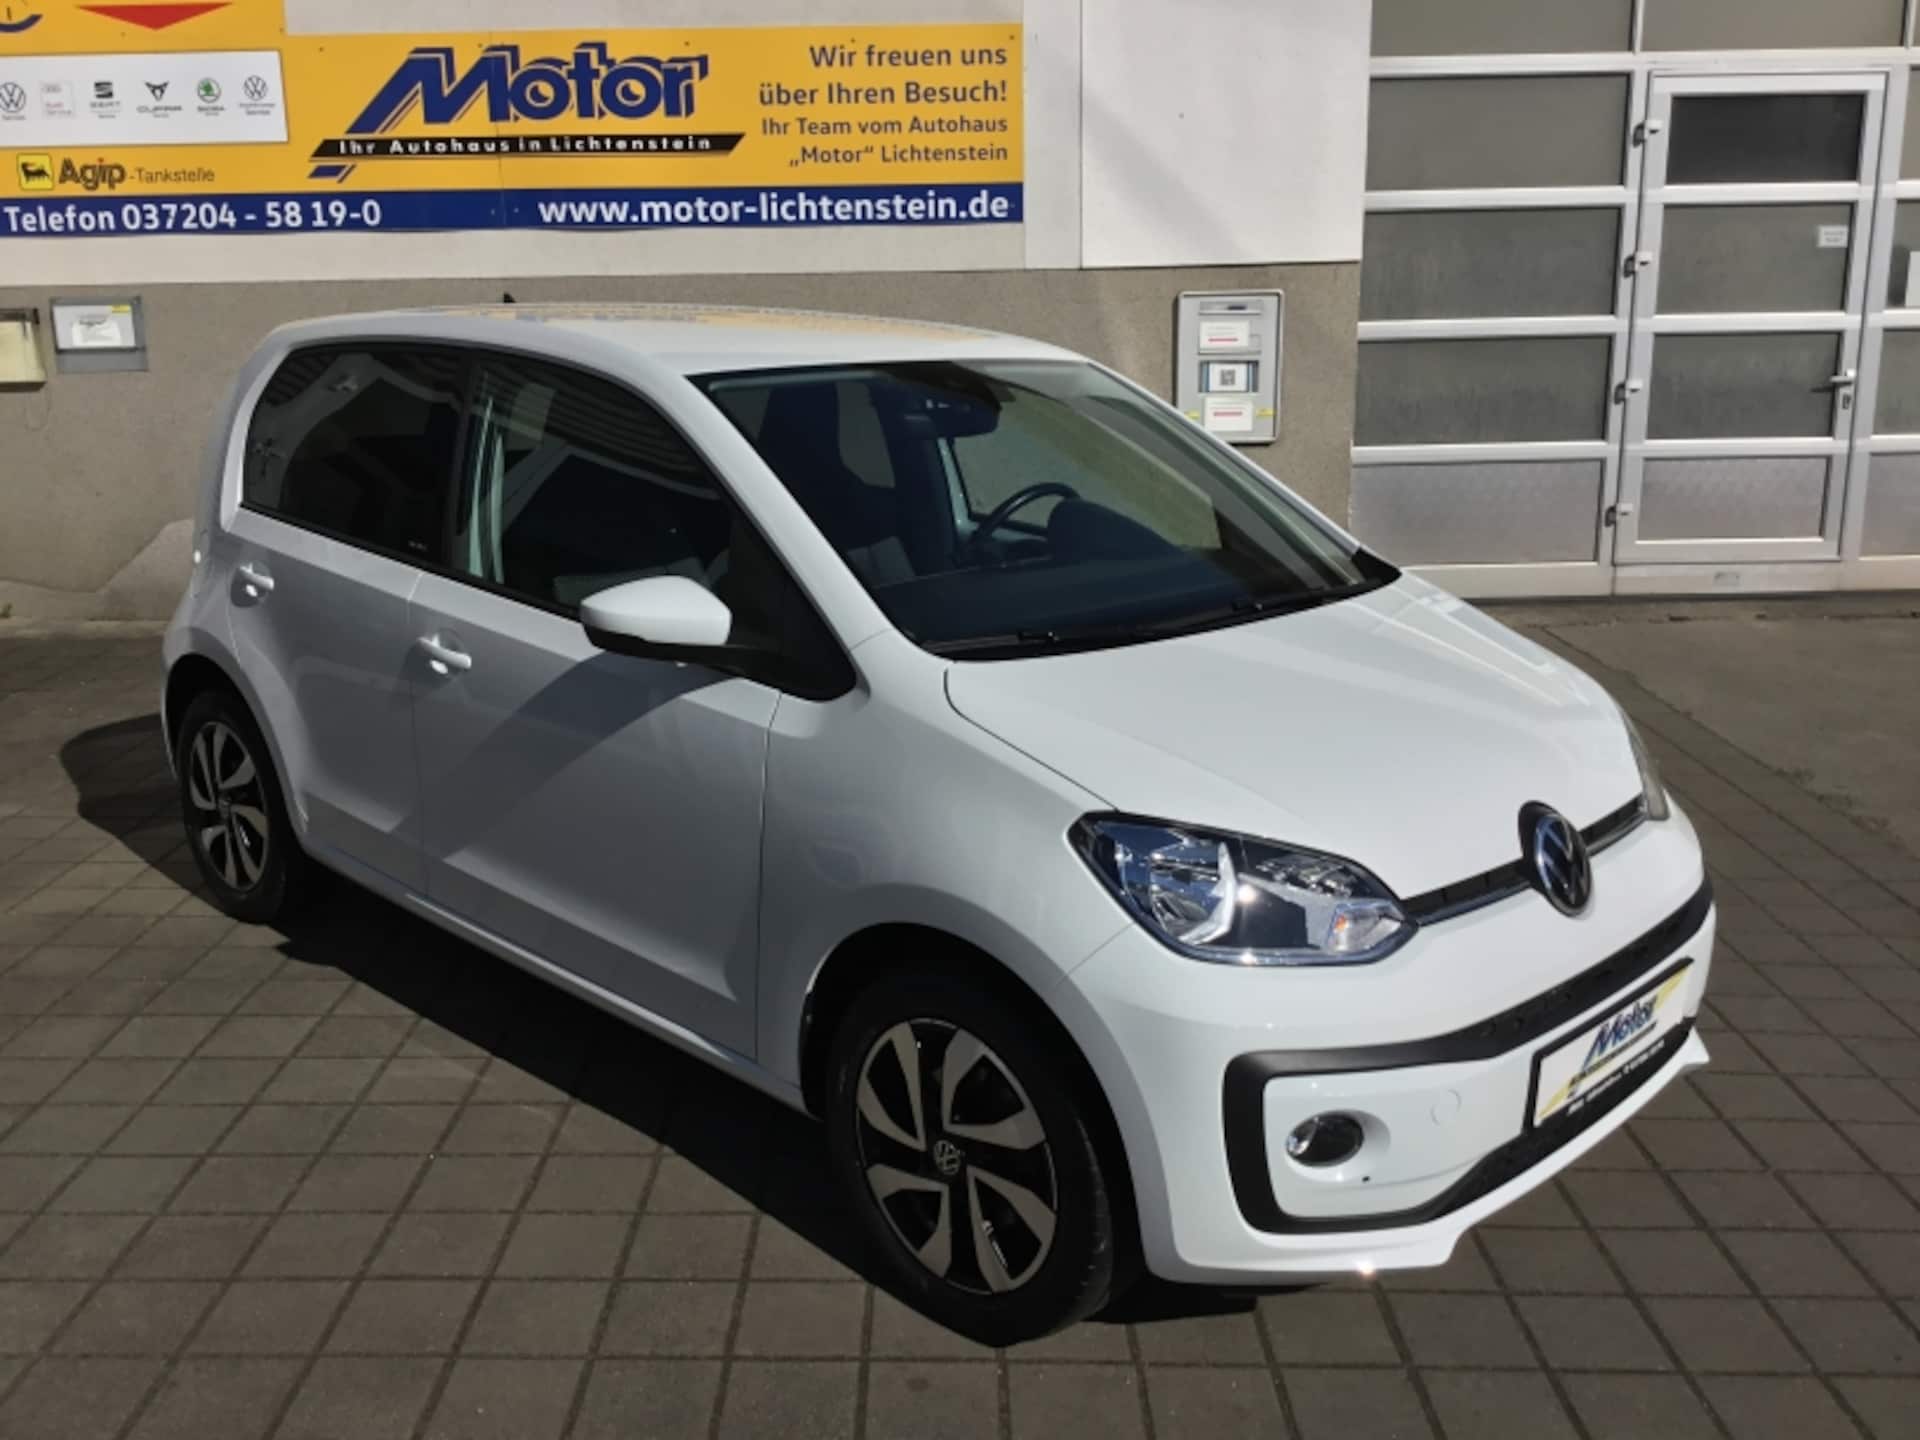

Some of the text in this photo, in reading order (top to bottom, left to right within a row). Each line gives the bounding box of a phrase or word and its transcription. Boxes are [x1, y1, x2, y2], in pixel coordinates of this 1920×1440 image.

[809, 44, 1008, 68] Wir freuen uns
[344, 41, 709, 135] Motor
[759, 79, 1008, 106] über Ihren Besuch!
[761, 114, 1008, 136] Ihr Team vom Autohaus
[339, 135, 710, 154] Ihr Autohaus in Lichtenstein
[881, 143, 1008, 162] Lichtenstein
[58, 157, 126, 191] Agip
[3, 204, 115, 232] Telefon
[121, 203, 237, 230] 037204
[265, 200, 303, 228] 58
[311, 199, 382, 228] 19-0
[538, 190, 1009, 224] www.motor-lichtenstein.de
